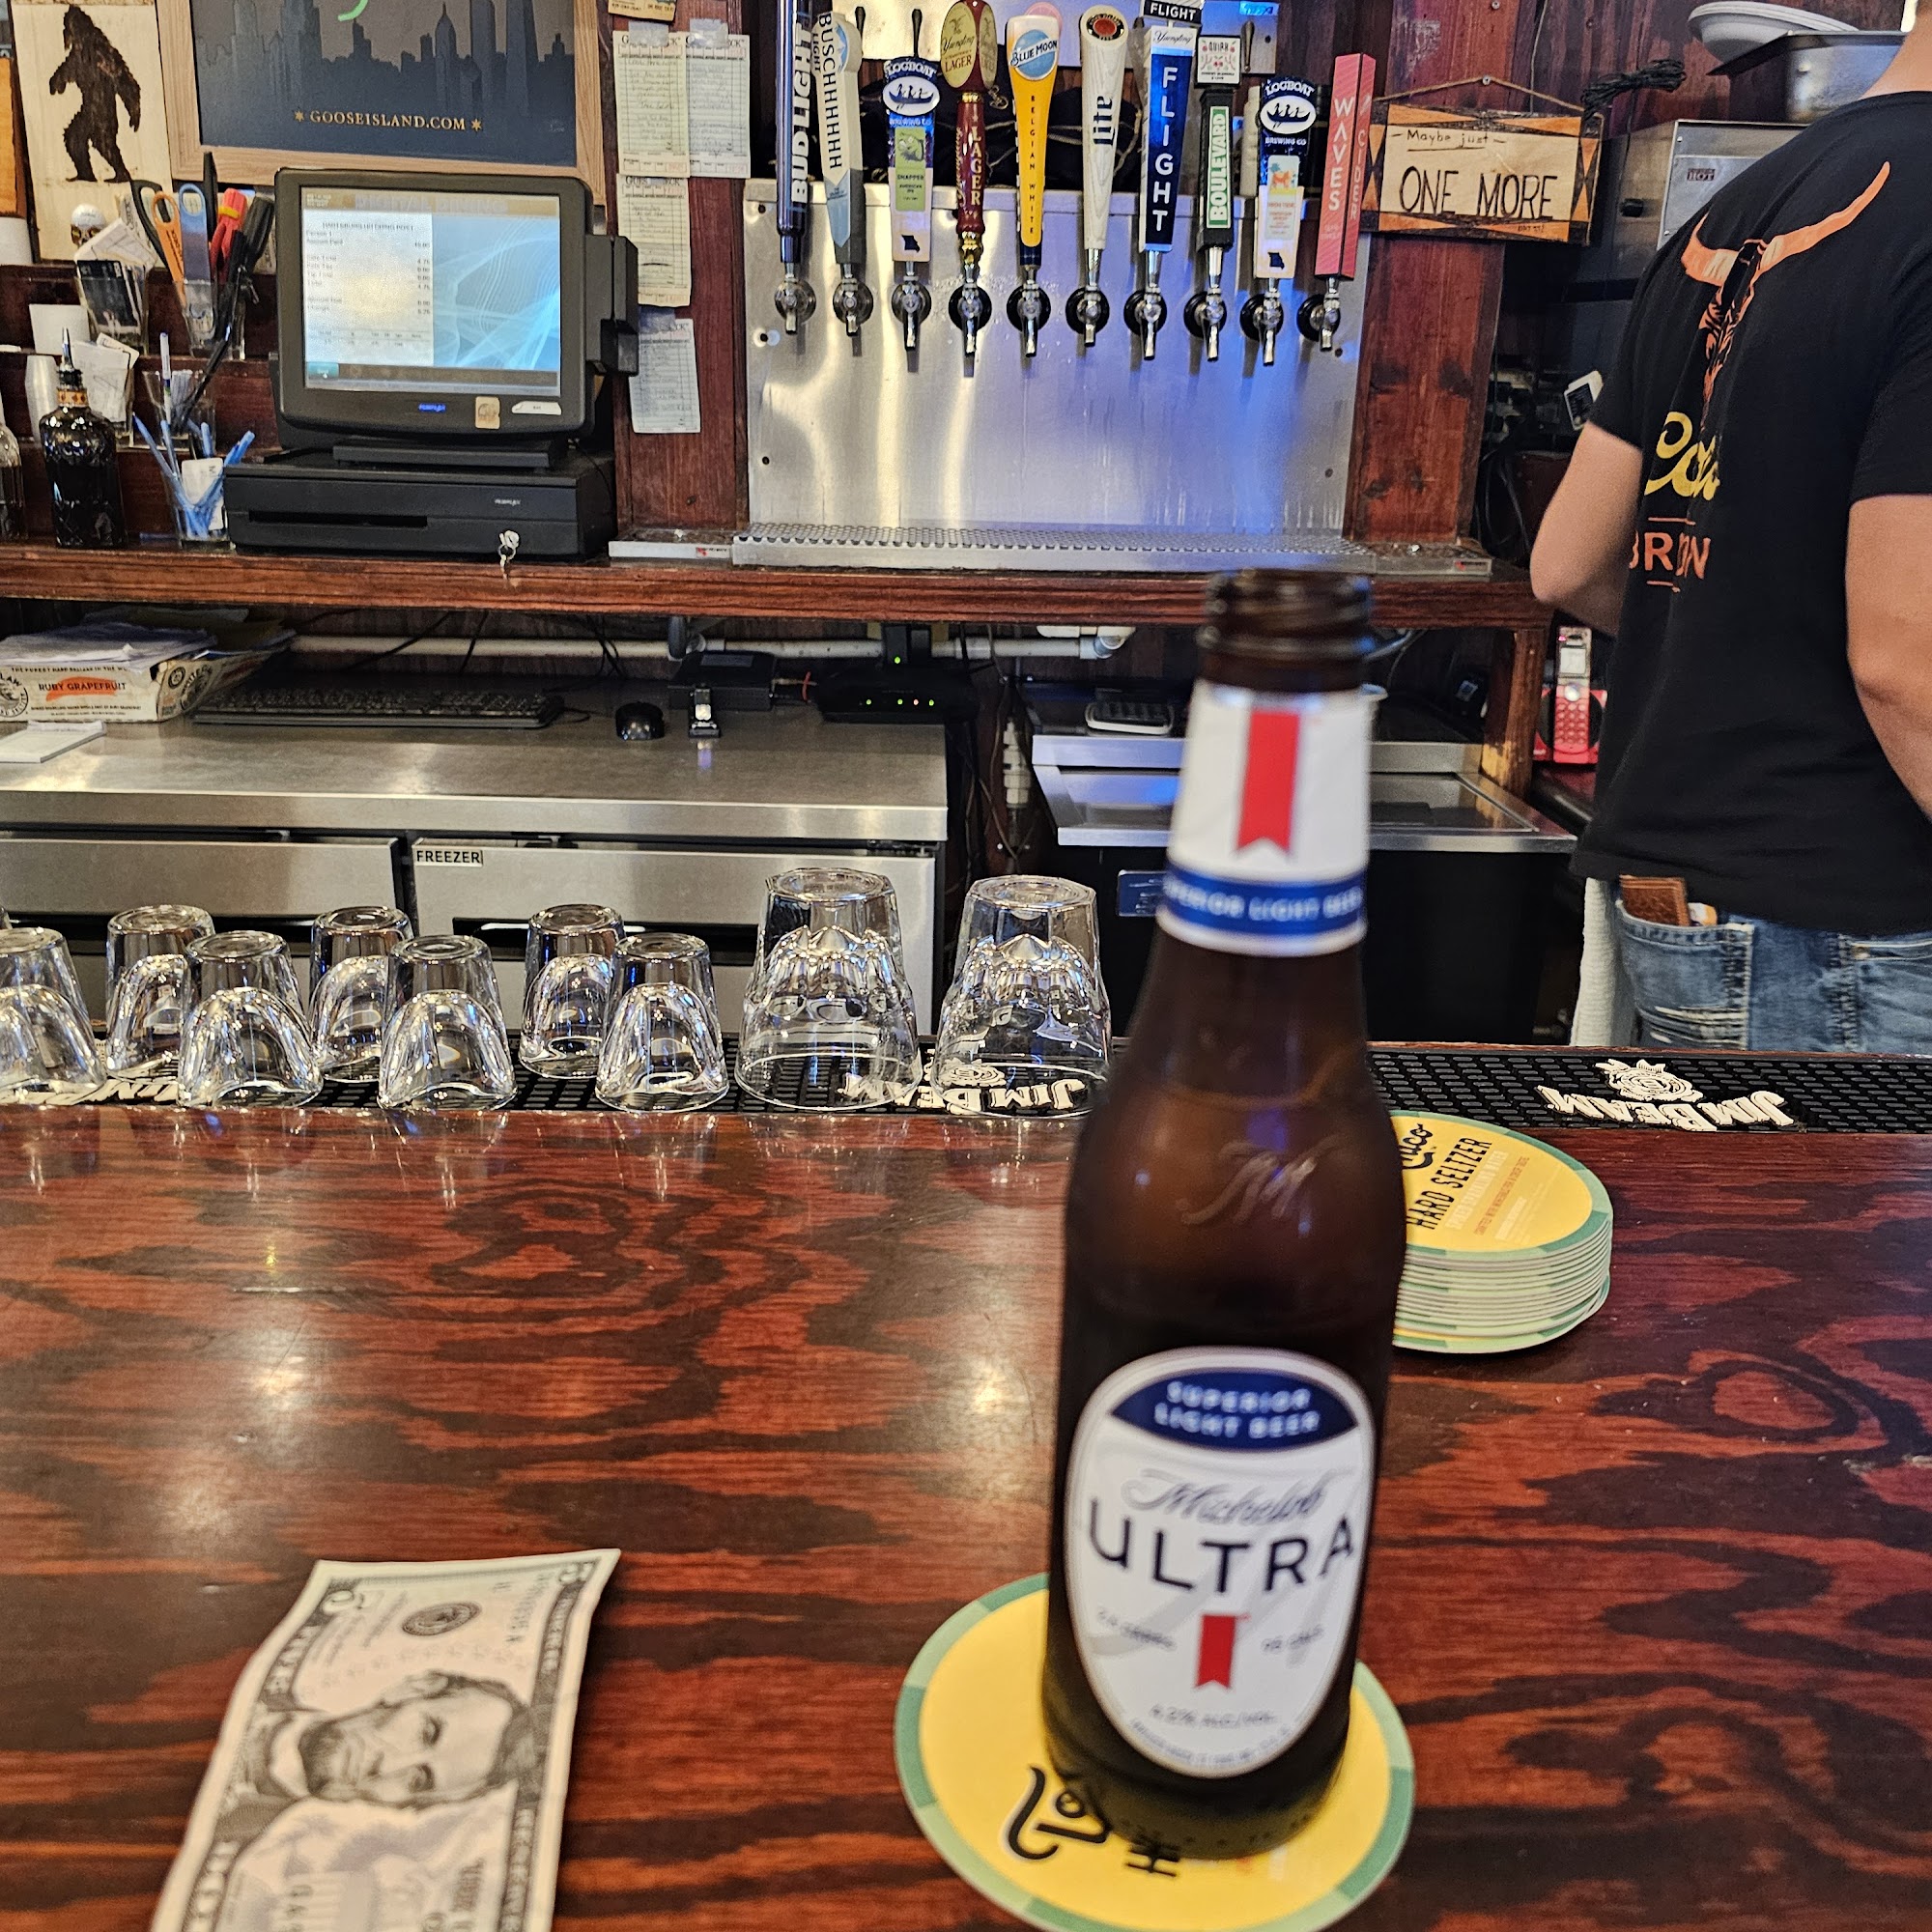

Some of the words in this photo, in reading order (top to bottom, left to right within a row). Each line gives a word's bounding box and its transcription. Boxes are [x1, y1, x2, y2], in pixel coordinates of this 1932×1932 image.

[1150, 4, 1197, 21] FLIGHT
[811, 33, 821, 71] LIGHT
[1010, 48, 1036, 67] BLUE
[1036, 40, 1058, 59] MOON
[1152, 29, 1194, 48] Yuengling
[793, 27, 811, 128] LIGHT
[945, 56, 973, 73] LAGER
[1264, 79, 1316, 97] LOGBOAT
[309, 110, 467, 131] GOOSEISLAND.COM
[1406, 128, 1452, 149] Maybe
[792, 128, 809, 203] BUD
[971, 128, 982, 206] LAGER
[1152, 66, 1178, 232] FLIGHT
[1209, 115, 1226, 222] BOULEVARD
[1328, 97, 1354, 212] WAVES
[1350, 128, 1366, 219] CIDER
[1399, 165, 1460, 216] ONE
[1477, 170, 1558, 220] MORE
[1028, 183, 1037, 235] WHITE
[38, 682, 64, 692] RUBY
[67, 682, 128, 692] GRAPEFRUIT
[416, 849, 482, 866] FREEZER
[989, 1078, 1086, 1109] JIM
[1534, 1084, 1718, 1132] BEAM
[1697, 1091, 1795, 1127] JIM
[1430, 1137, 1492, 1189] SELTZER
[1406, 1190, 1455, 1230] HARD
[1090, 1497, 1354, 1594] ULTRA
